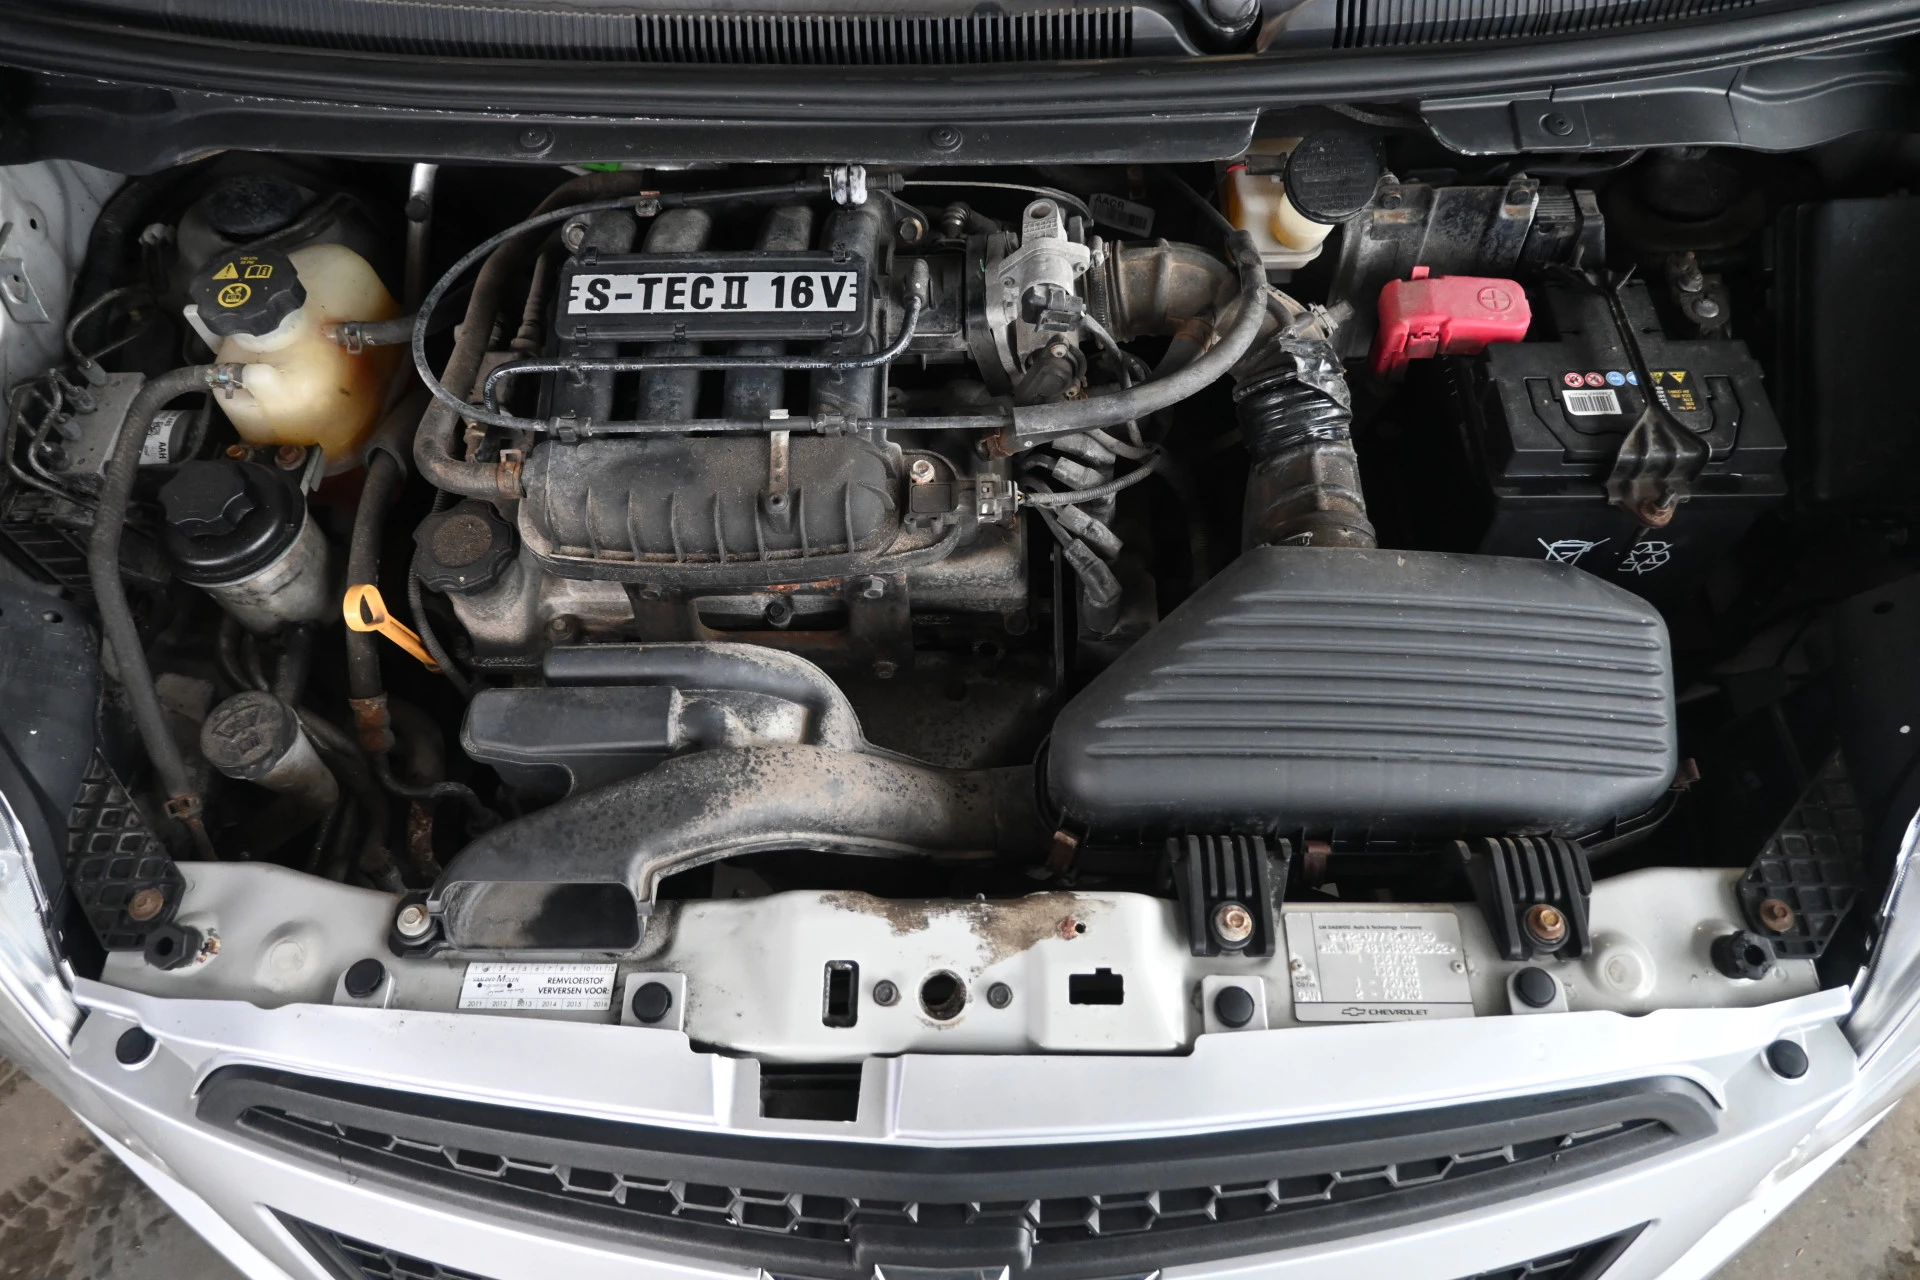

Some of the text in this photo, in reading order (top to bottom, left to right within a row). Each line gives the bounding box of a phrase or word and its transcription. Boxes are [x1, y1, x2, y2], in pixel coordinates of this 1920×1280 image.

[1095, 194, 1125, 210] AACR
[770, 275, 848, 309] 16V
[547, 977, 604, 985] REMVLOEISTOF
[538, 987, 610, 995] VERVERSEN VOOR:
